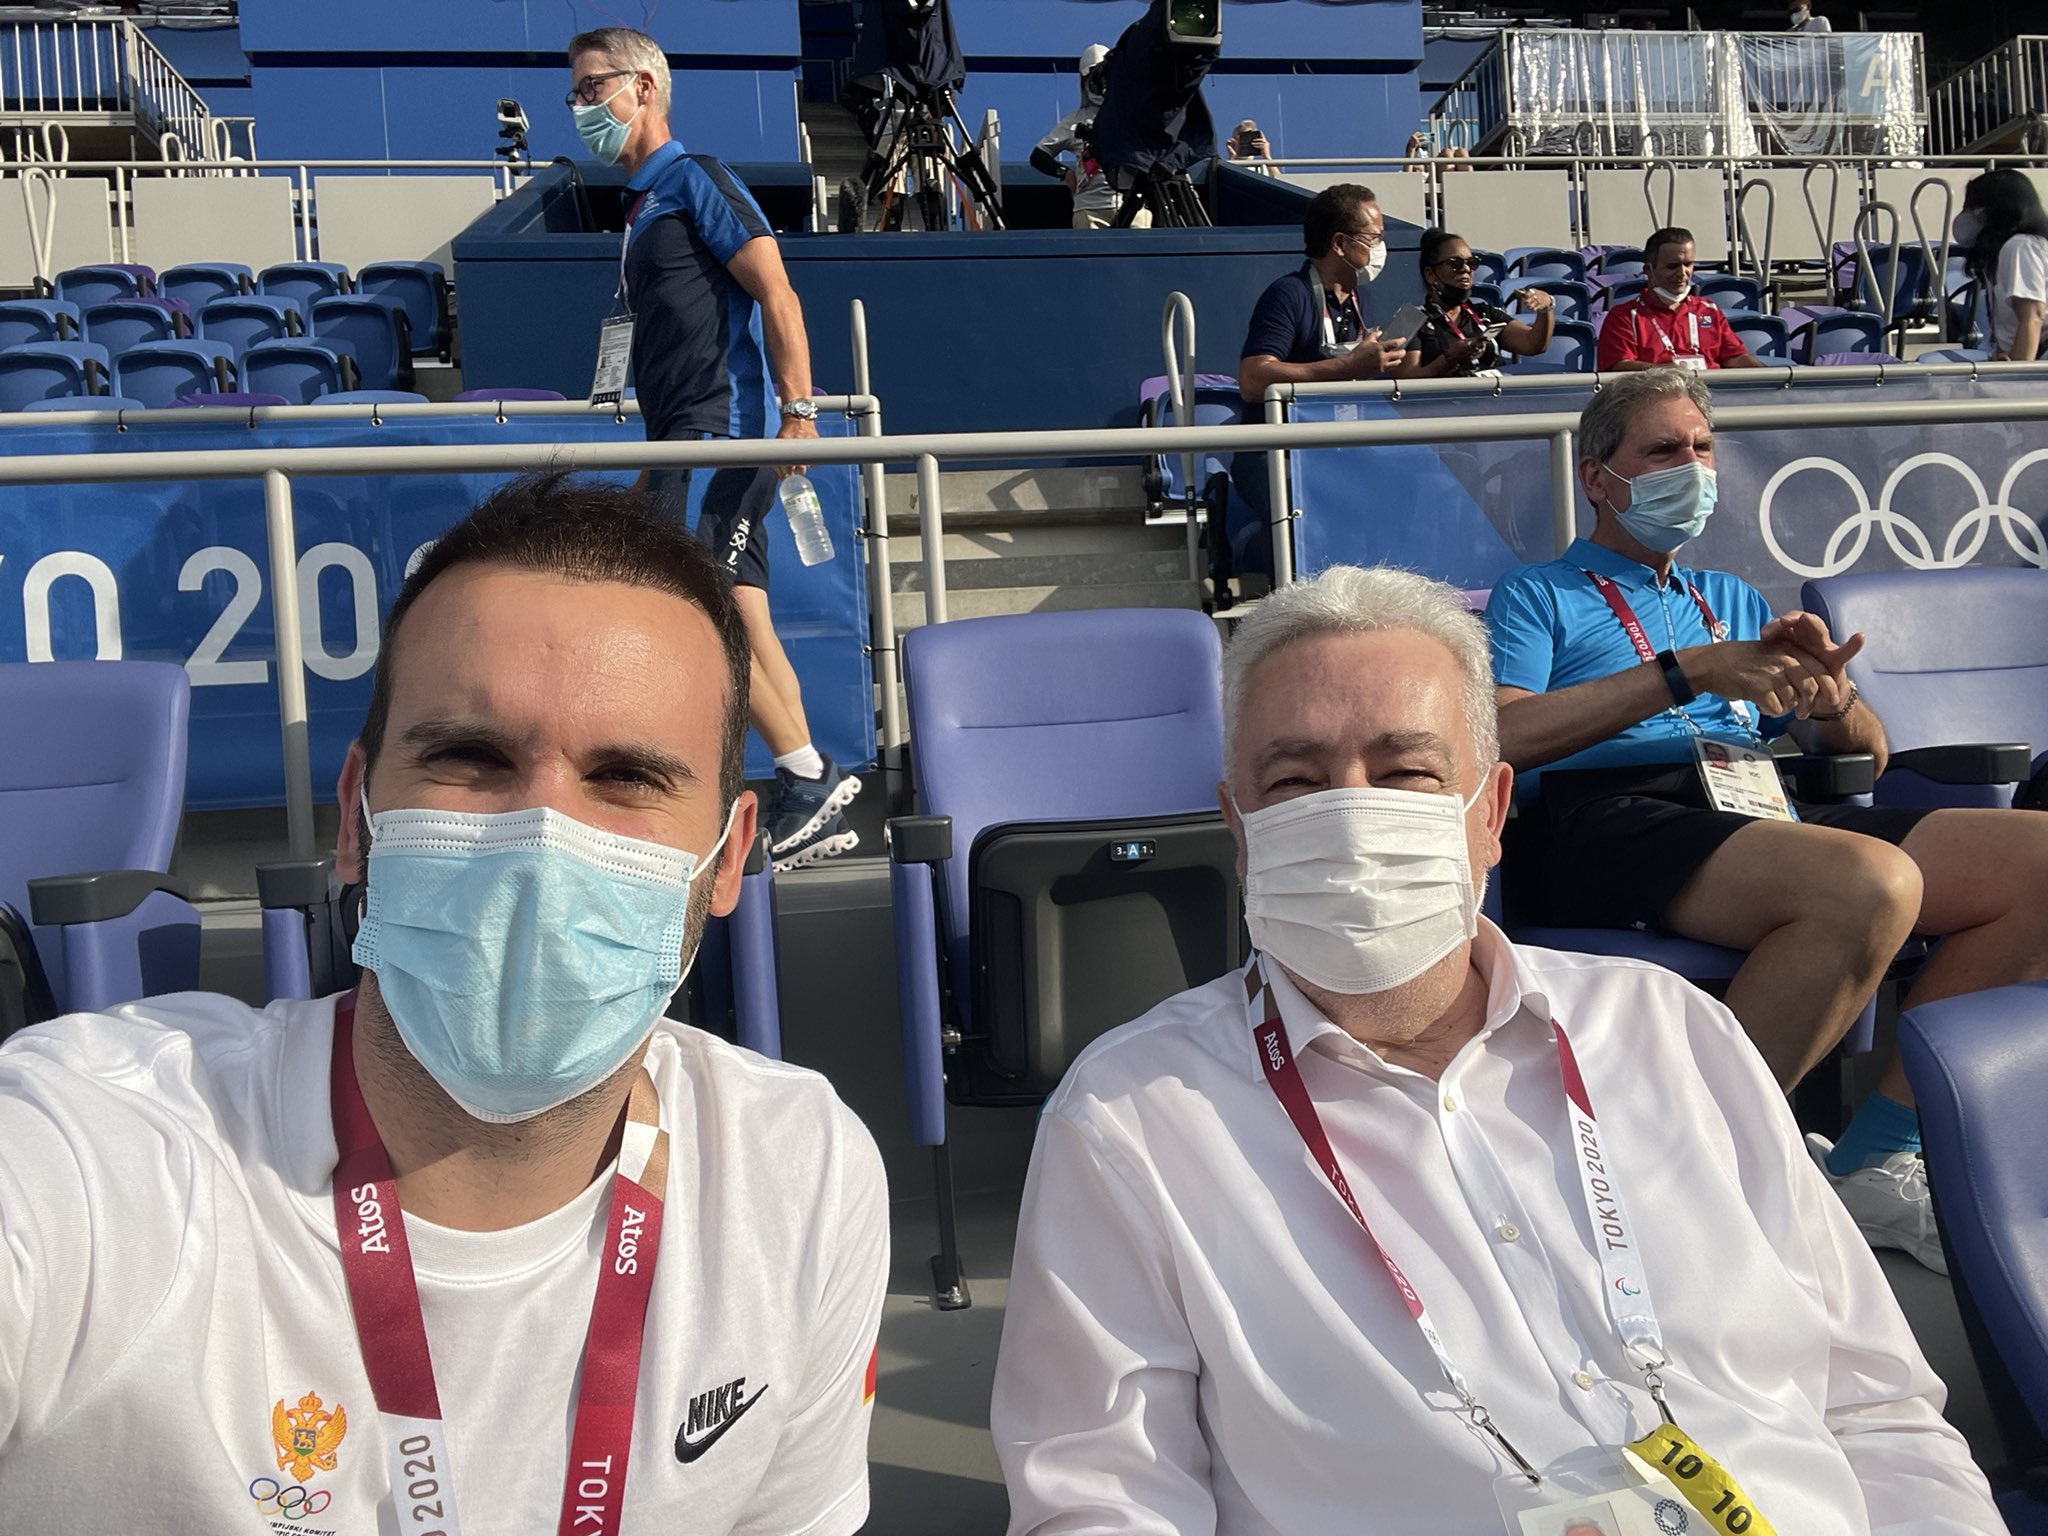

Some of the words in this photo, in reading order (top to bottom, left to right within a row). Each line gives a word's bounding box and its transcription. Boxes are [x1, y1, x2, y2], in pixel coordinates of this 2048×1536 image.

[1627, 621, 1649, 650] TOKYO
[1128, 844, 1139, 856] A
[1264, 1031, 1285, 1071] Atos
[1578, 1120, 1606, 1175] 2020
[351, 1182, 390, 1254] Atos
[614, 1204, 645, 1275] Atos
[1590, 1178, 1628, 1251] TOKYO
[686, 1376, 746, 1436] NIKE
[398, 1434, 444, 1522] 2020
[1661, 1440, 1704, 1480] 10
[572, 1454, 612, 1536] TOK
[1711, 1489, 1753, 1535] 10
